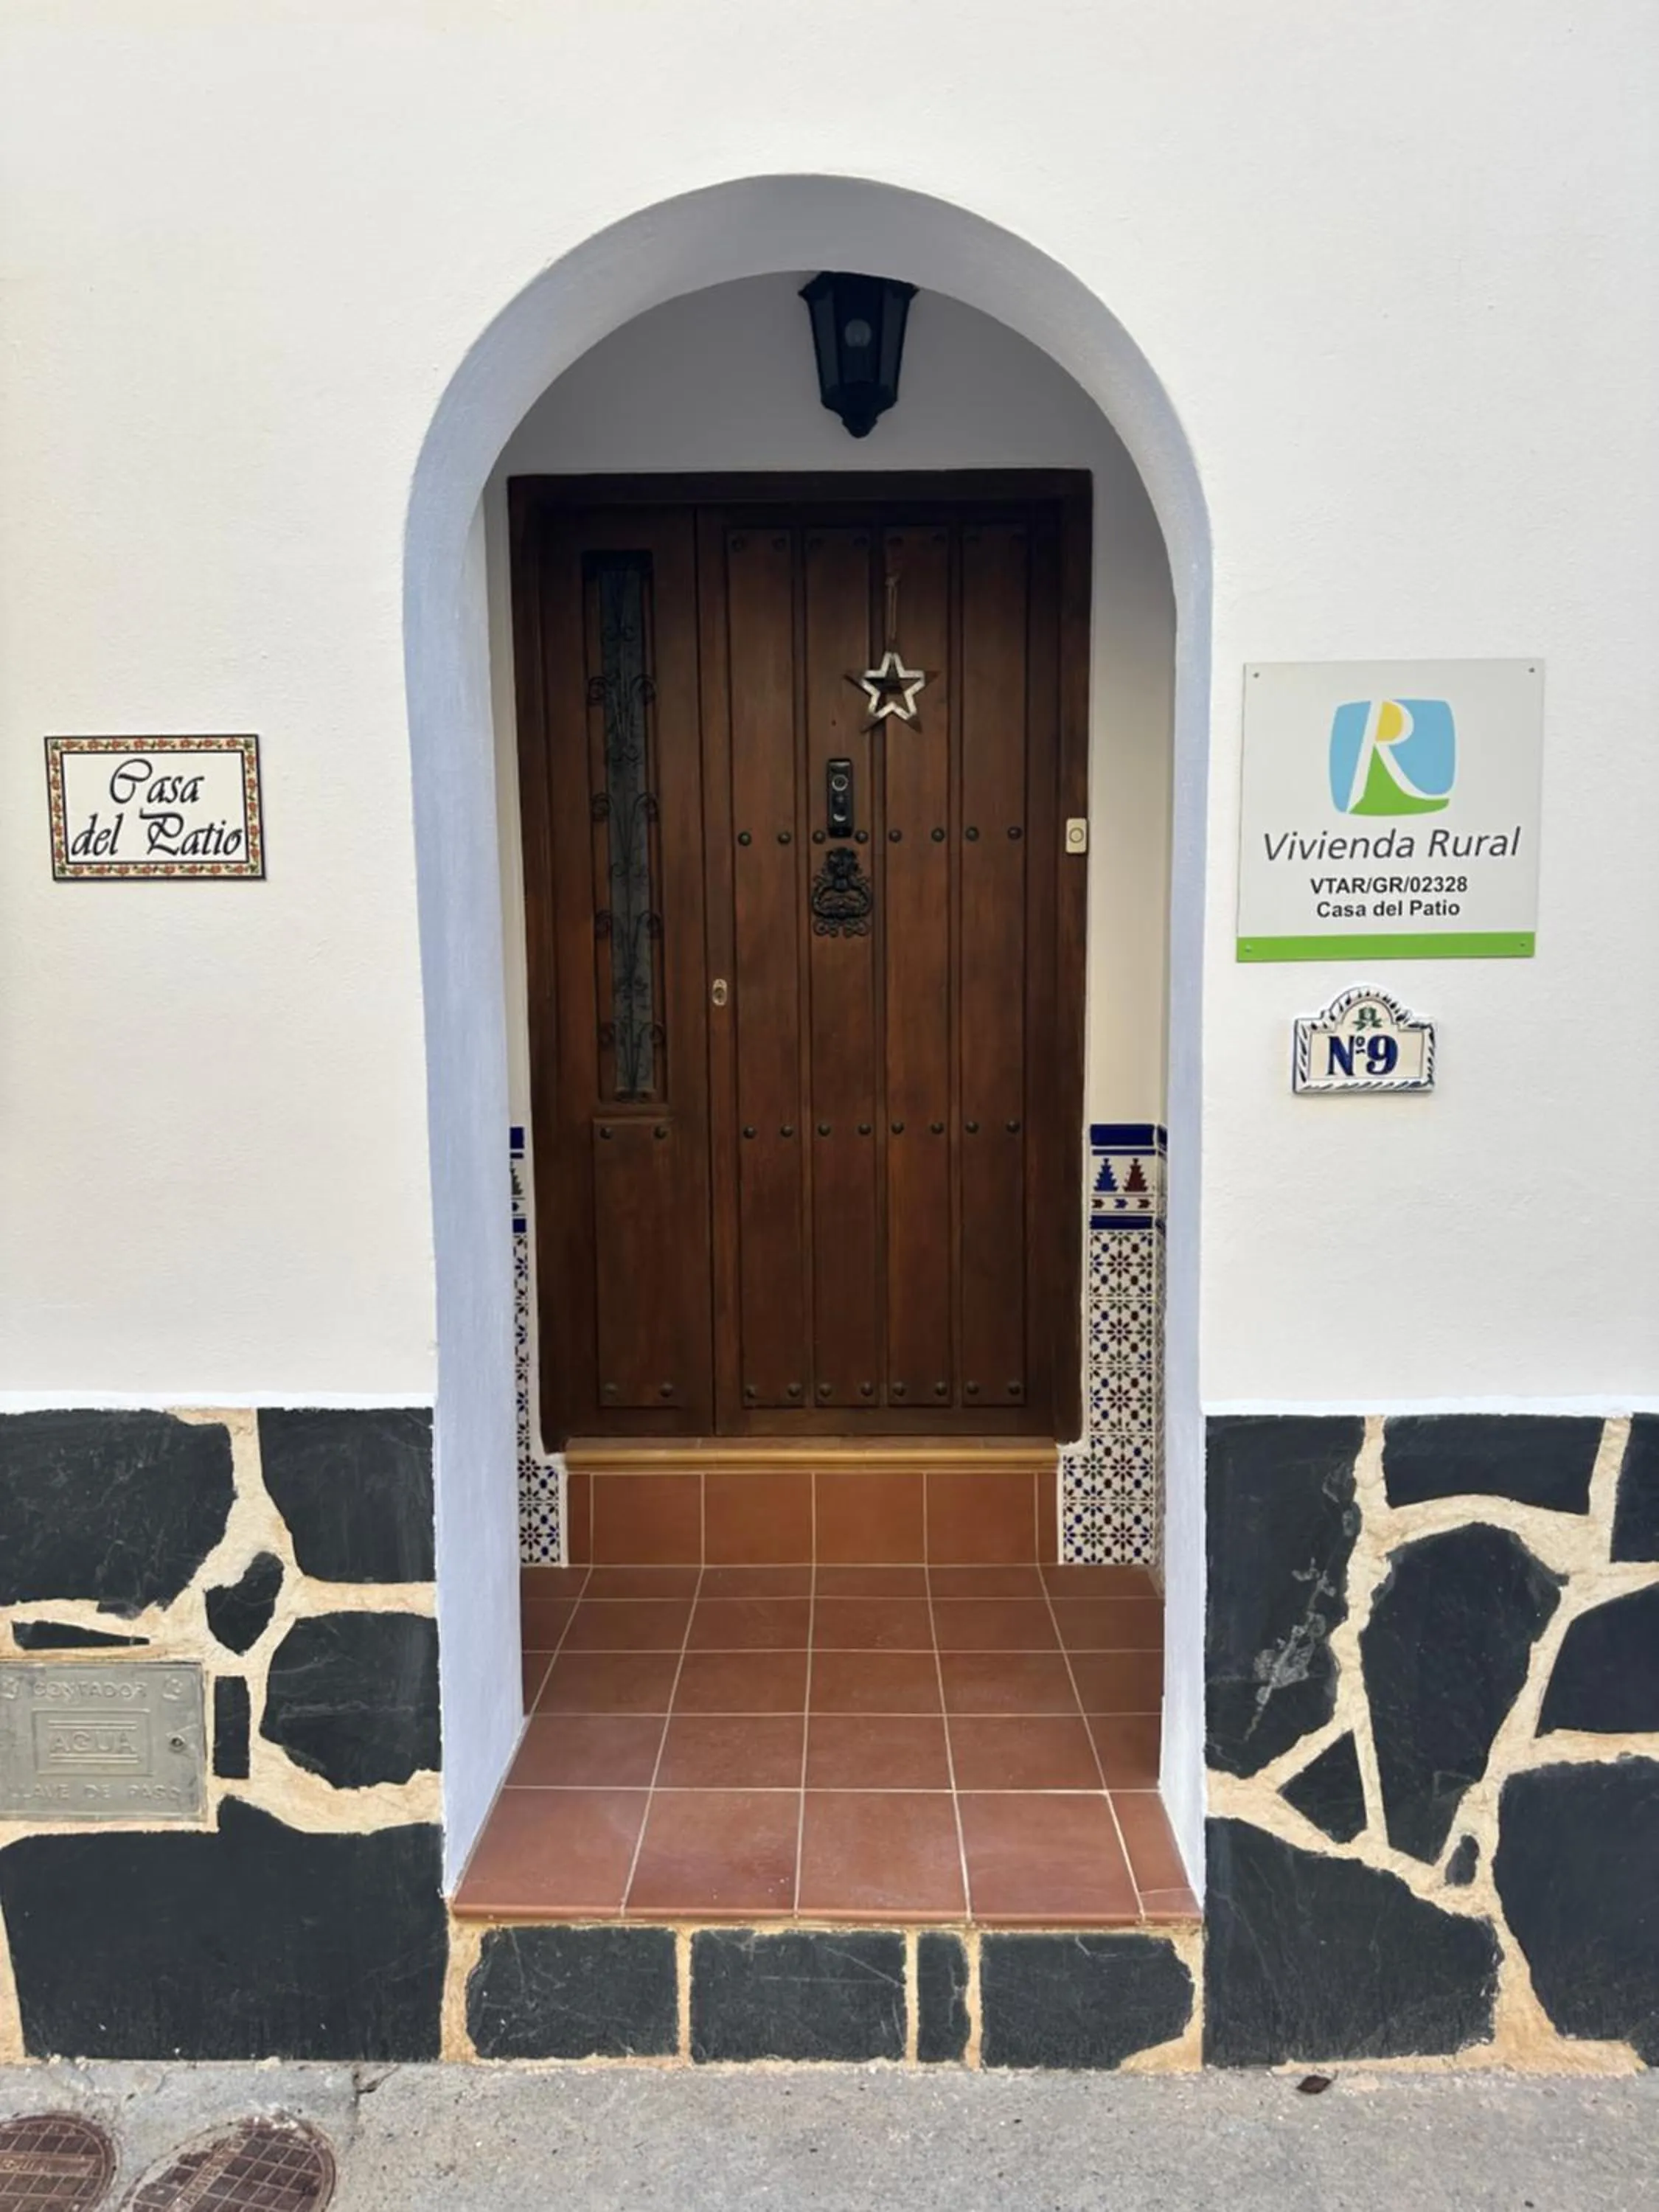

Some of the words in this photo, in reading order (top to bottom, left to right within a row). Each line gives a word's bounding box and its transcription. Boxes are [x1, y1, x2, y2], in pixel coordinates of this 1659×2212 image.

[110, 759, 204, 804] Casa
[72, 813, 123, 856] del
[139, 809, 242, 855] Patio
[1265, 829, 1414, 860] Vivienda
[1428, 827, 1520, 857] Rural
[1311, 876, 1467, 894] VTAR/GR/02328
[1317, 902, 1366, 917] Casa
[1374, 900, 1402, 916] del
[1410, 900, 1460, 916] Patio
[49, 1731, 137, 1752] AGUA
